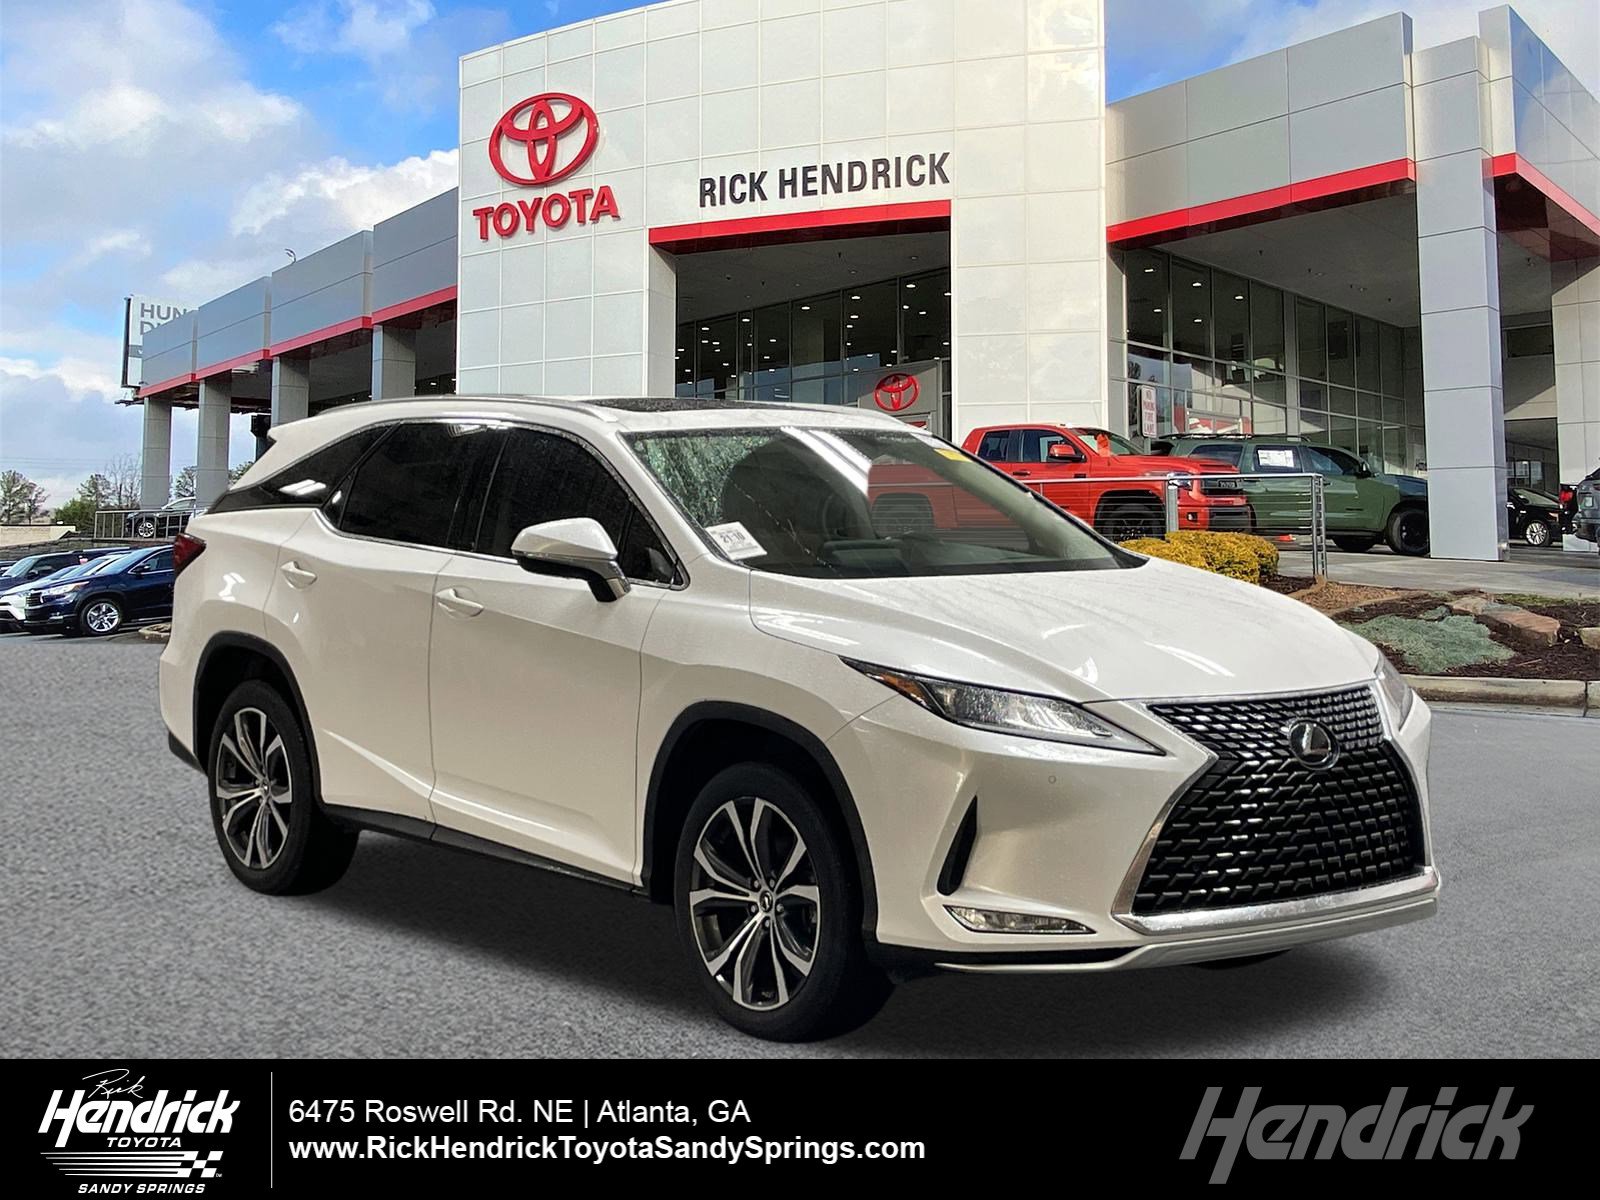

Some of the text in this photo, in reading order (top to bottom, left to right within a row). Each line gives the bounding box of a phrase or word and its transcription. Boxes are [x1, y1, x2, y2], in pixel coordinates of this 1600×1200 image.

[699, 152, 950, 208] RICK HENDRICK
[473, 185, 620, 240] TOYOTA
